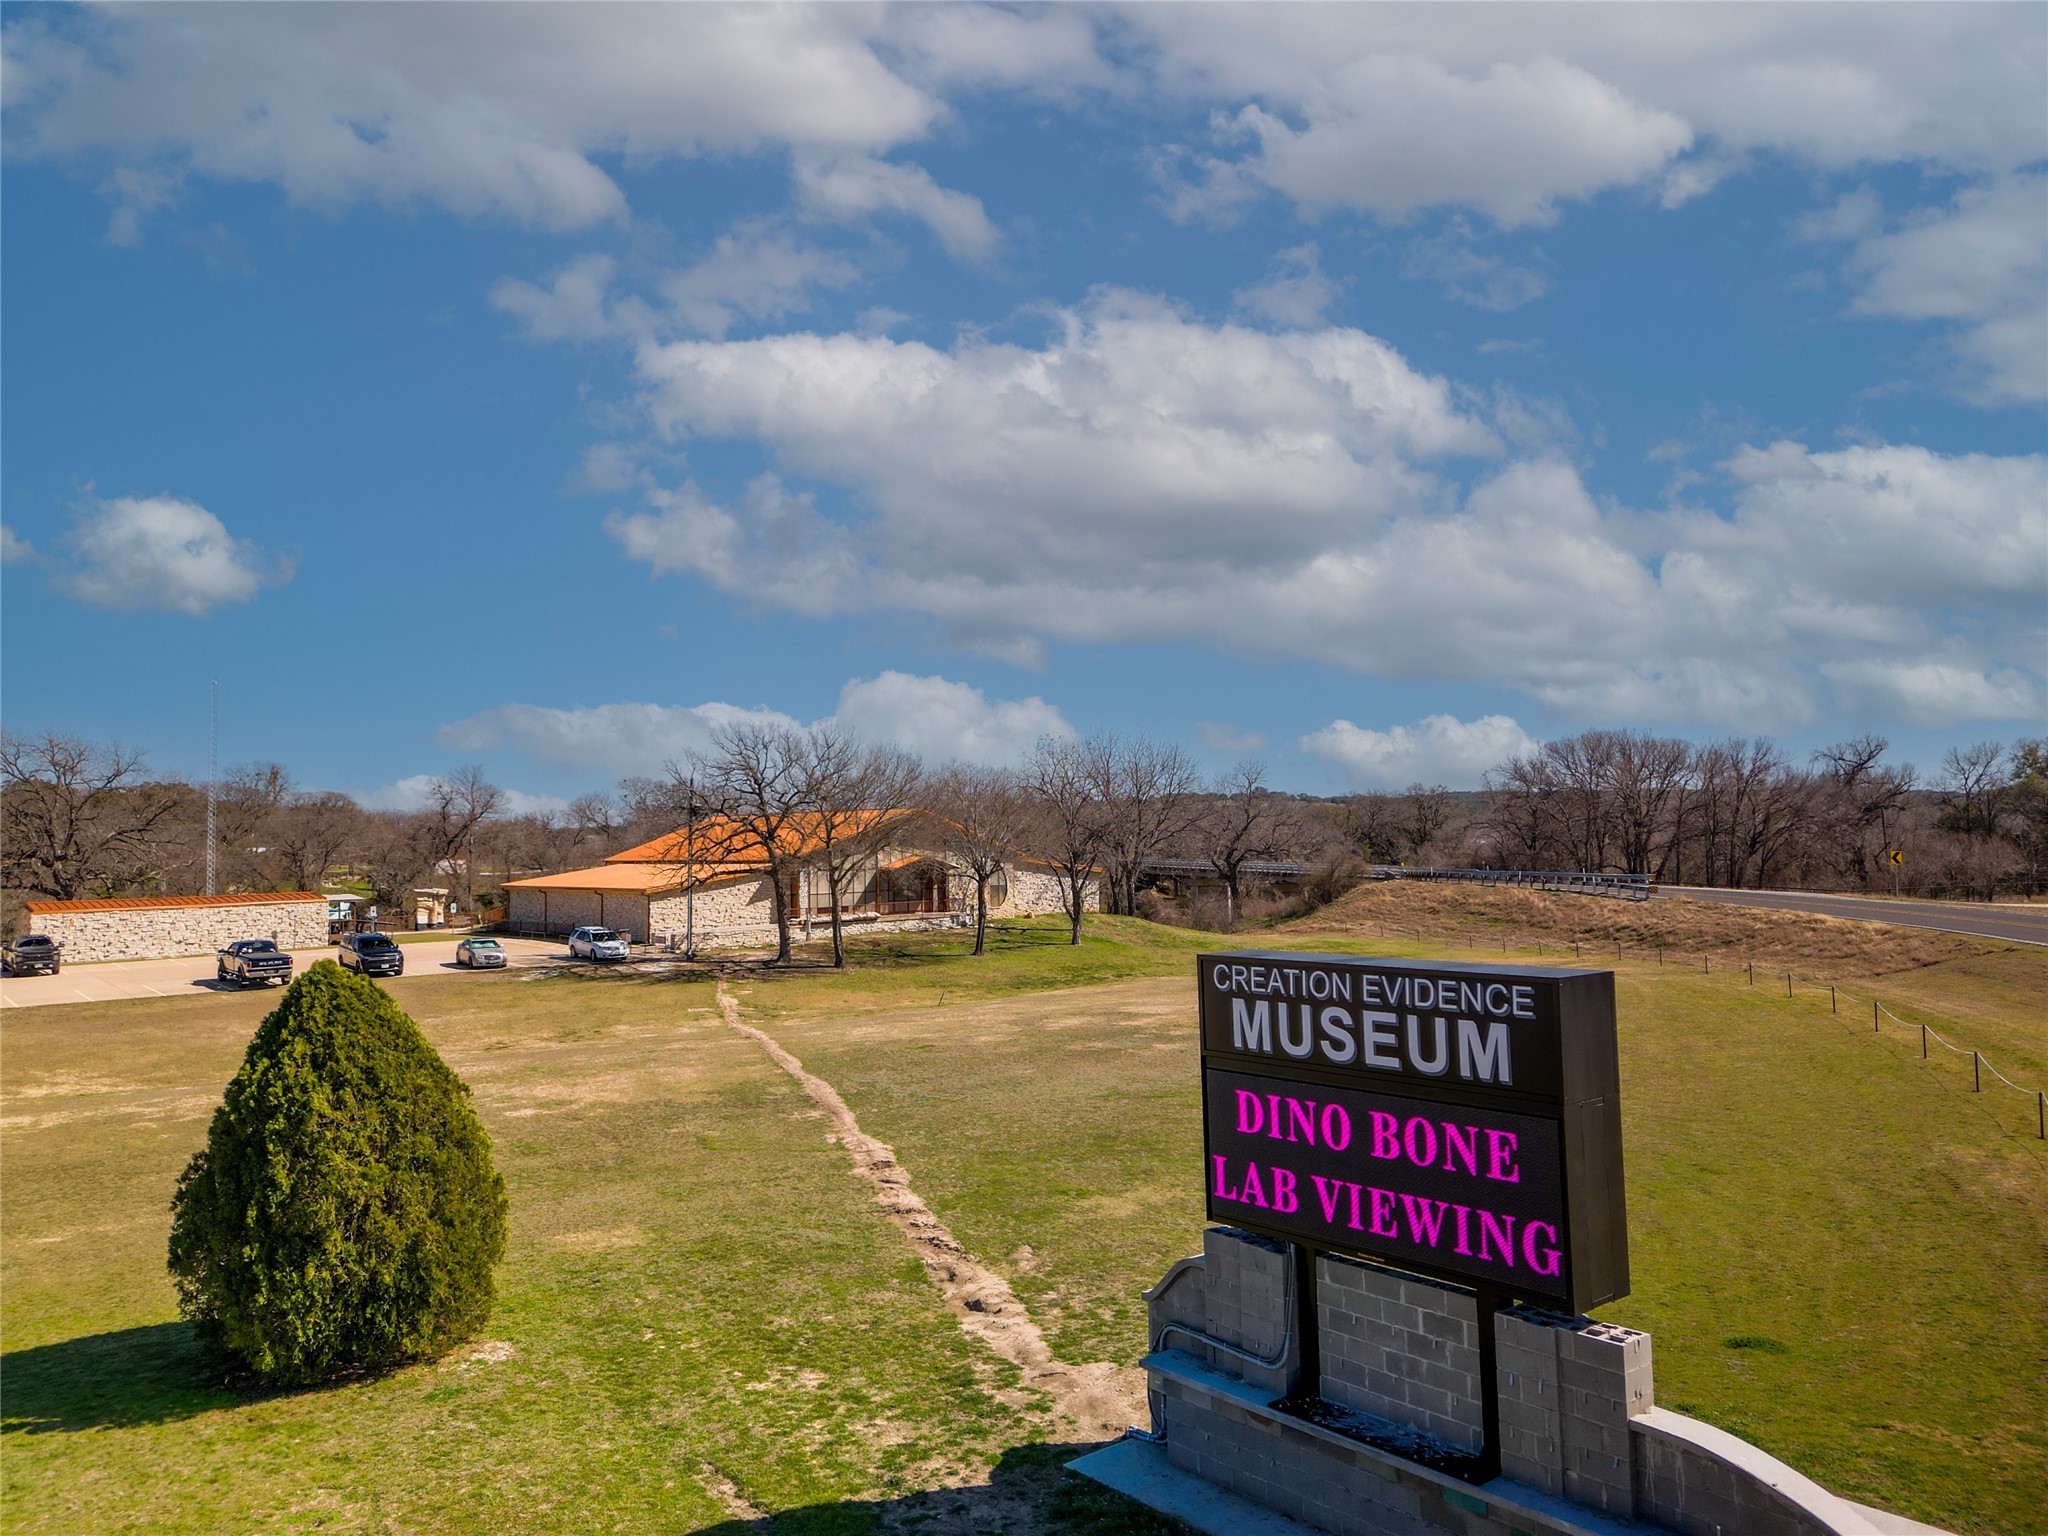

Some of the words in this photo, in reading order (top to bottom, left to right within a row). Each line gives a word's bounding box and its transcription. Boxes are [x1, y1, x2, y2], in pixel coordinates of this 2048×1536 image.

[1212, 964, 1352, 1000] CREATION
[1362, 974, 1536, 1018] EVIDENCE
[1232, 998, 1512, 1085] MUSEUM
[1235, 1089, 1352, 1152] DINO
[1368, 1111, 1520, 1184] BONE
[1212, 1154, 1299, 1214] LAB
[1310, 1174, 1562, 1277] VIEWING
